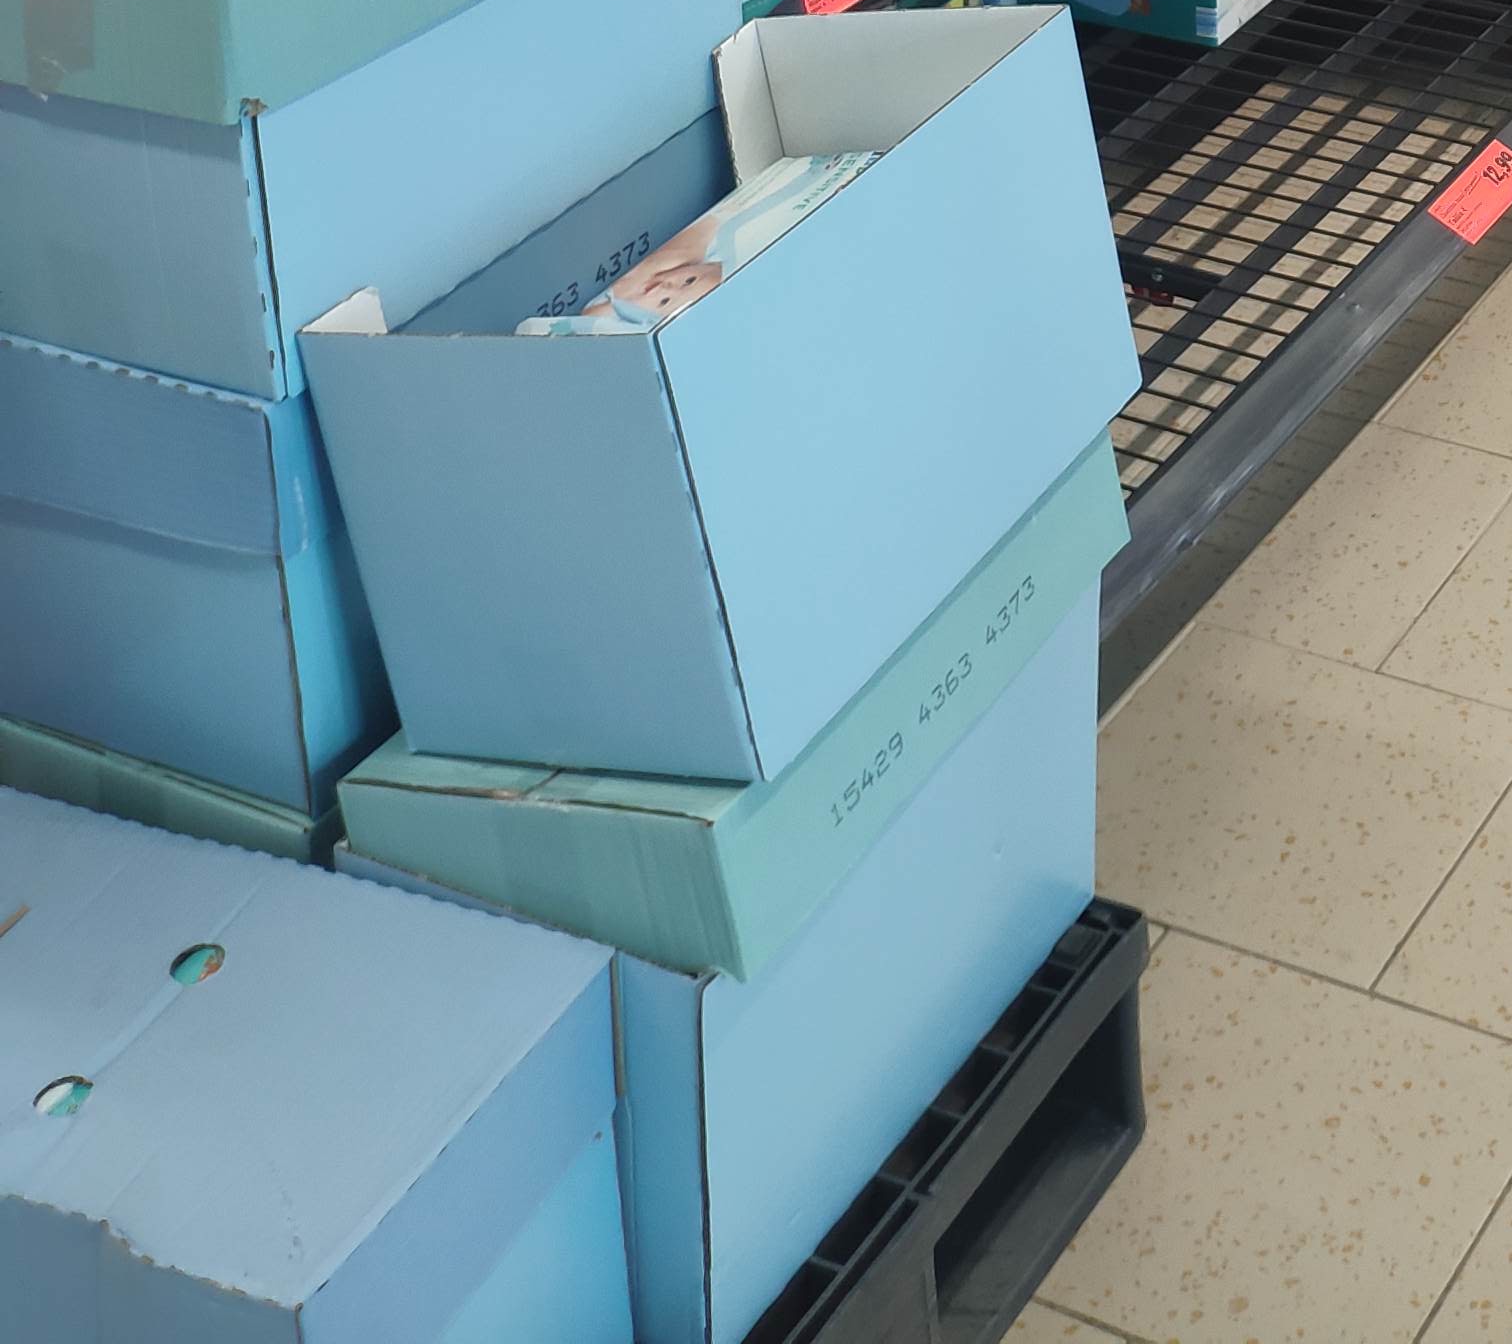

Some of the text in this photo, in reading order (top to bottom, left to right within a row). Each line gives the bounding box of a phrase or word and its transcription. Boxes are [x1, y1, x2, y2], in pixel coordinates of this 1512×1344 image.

[537, 231, 652, 319] 363 4373
[829, 573, 1039, 829] 15429 4363 4373
